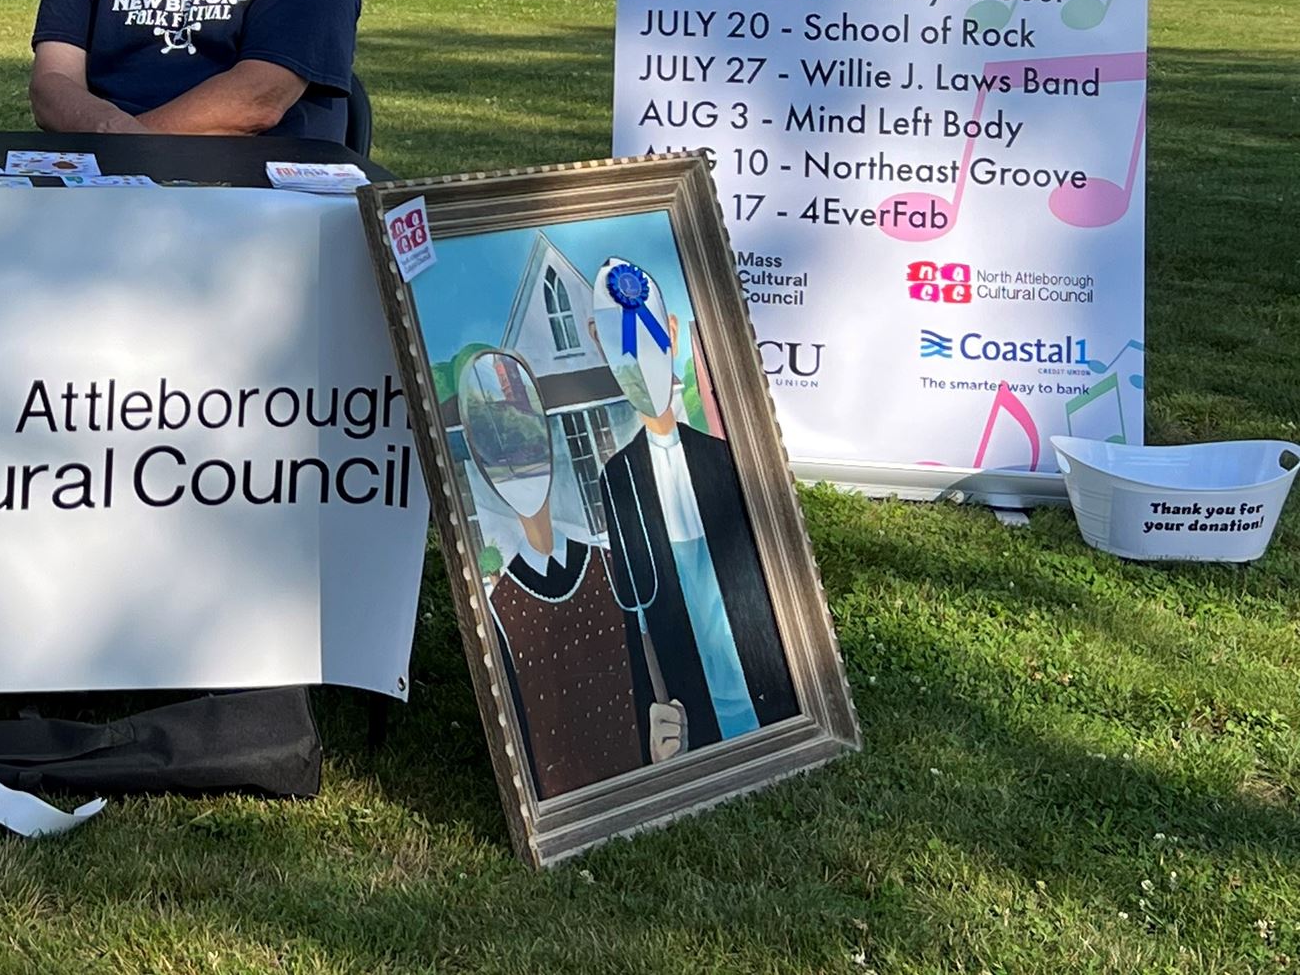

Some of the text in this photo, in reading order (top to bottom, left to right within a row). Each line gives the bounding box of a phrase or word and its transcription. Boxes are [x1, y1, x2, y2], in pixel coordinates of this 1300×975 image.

[124, 5, 232, 28] FOLK FTIVAL
[640, 10, 717, 38] JULY
[727, 11, 770, 39] 20
[804, 13, 909, 44] School
[920, 15, 952, 45] of
[962, 18, 1036, 49] Rock
[639, 55, 717, 83] JULY
[727, 57, 767, 84] 27
[801, 58, 891, 89] Willie
[900, 62, 924, 91] J.
[937, 64, 1012, 94] Laws
[1024, 66, 1100, 97] Band
[638, 100, 718, 128] AUG
[731, 100, 749, 130] 3
[785, 104, 866, 134] Mind
[878, 108, 933, 138] Left
[944, 111, 1024, 147] Body
[733, 148, 768, 176] 10
[804, 152, 959, 183] Northeast
[970, 158, 1087, 189] Groove
[732, 194, 766, 221] 17
[800, 198, 948, 229] 4EverFab
[738, 251, 783, 268] Mass
[738, 270, 808, 287] Cultural
[977, 270, 1094, 290] North Attleborough
[977, 285, 1094, 303] Cultural Council
[960, 333, 1089, 365] Coastal1
[775, 379, 819, 388] UNION
[920, 377, 1090, 395] The smarter way to bank
[18, 375, 412, 439] Attleborough
[134, 443, 411, 509] Council
[1150, 502, 1264, 519] Thank you for
[1143, 516, 1264, 534] your donation!
